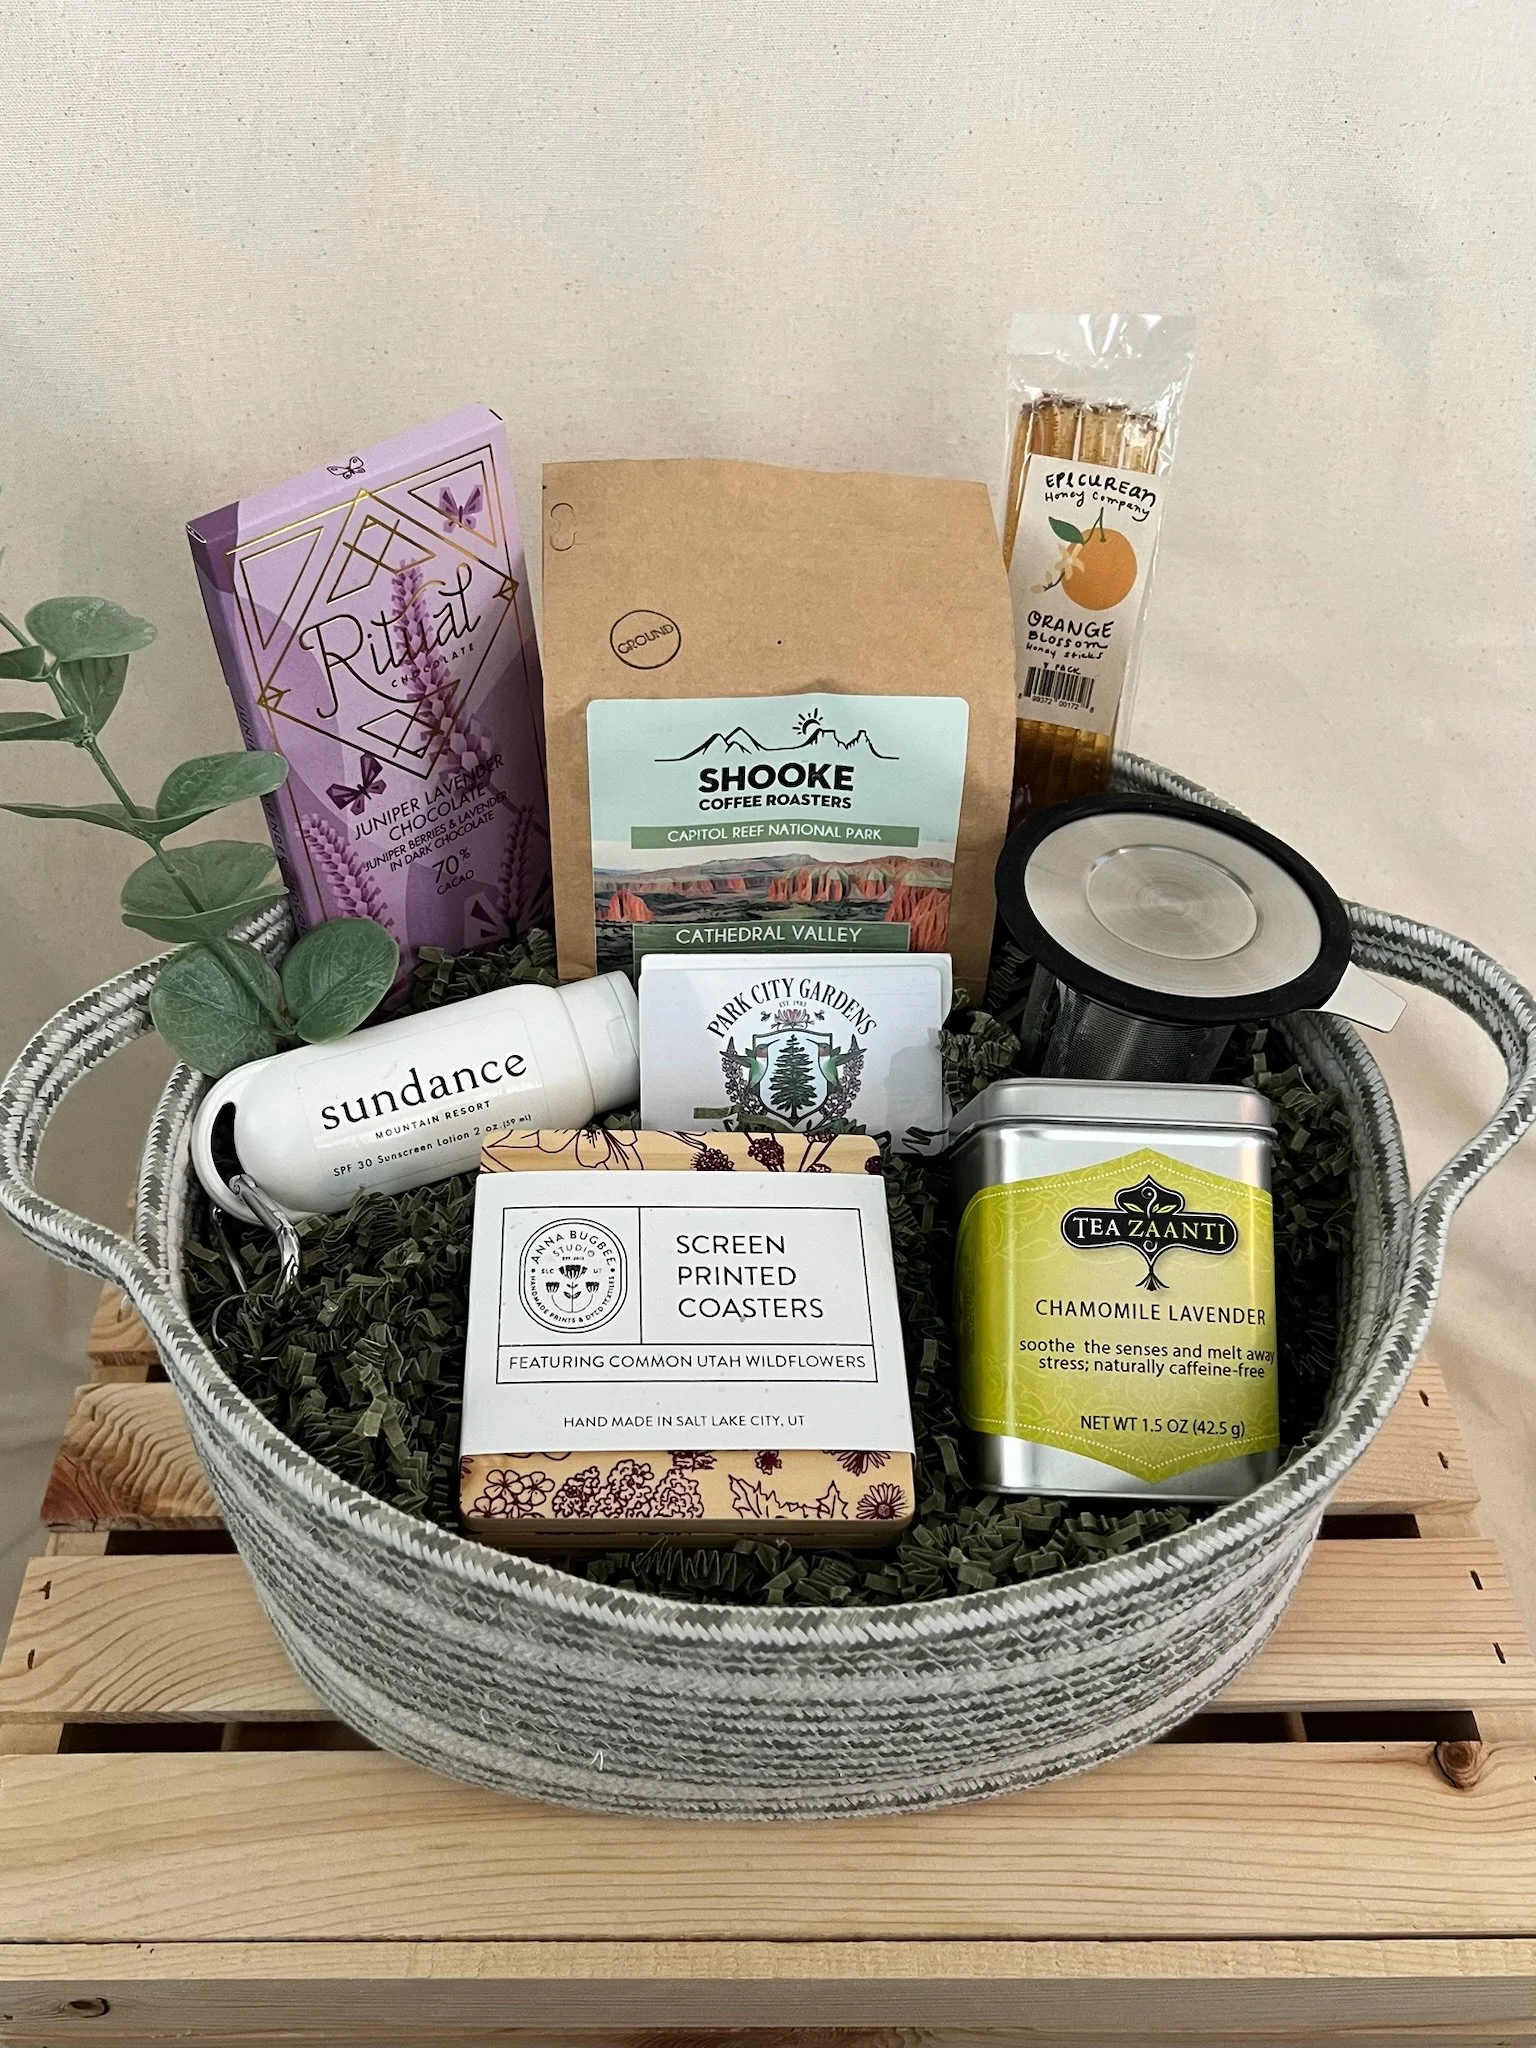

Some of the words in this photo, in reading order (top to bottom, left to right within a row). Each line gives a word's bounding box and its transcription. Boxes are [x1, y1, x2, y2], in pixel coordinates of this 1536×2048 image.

[1045, 490, 1085, 508] Honey
[1027, 610, 1115, 639] ORANGE
[299, 563, 481, 719] Ritual
[616, 623, 674, 655] GROUND
[391, 643, 475, 688] CHOCOLATE
[1055, 664, 1081, 675] PACK
[698, 762, 855, 793] SHOOKE
[355, 797, 421, 841] JUNIPER
[425, 753, 504, 806] LAVENDER
[698, 795, 762, 811] COFFEE
[766, 794, 852, 810] ROASTERS
[389, 782, 486, 841] CHOCOLATE
[364, 844, 407, 873] JUNIPER
[408, 824, 447, 850] BERRIES
[449, 818, 457, 830] &
[458, 790, 508, 825] LAVENDER
[390, 858, 403, 872] IN
[405, 842, 433, 865] DARK
[434, 811, 495, 849] CHOCOLATE
[667, 826, 729, 842] CAPITOL
[732, 824, 765, 839] REEF
[768, 823, 842, 840] NATIONAL
[846, 826, 882, 841] PARK
[437, 869, 474, 895] CACAO
[675, 925, 786, 945] CATHEDRAL
[791, 925, 863, 944] VALLEY
[706, 992, 753, 1038] PARK
[751, 977, 795, 1004] CITY
[799, 978, 877, 1036] GARDENS
[321, 1053, 528, 1131] sundance
[374, 1113, 441, 1140] MOUNTAIN
[444, 1099, 492, 1120] RESORT
[333, 1163, 354, 1177] SPF
[357, 1157, 373, 1170] 30
[377, 1143, 433, 1166] Sunscreen
[436, 1132, 470, 1147] Lotion
[473, 1126, 481, 1136] 2
[676, 1234, 786, 1254] SCREEN
[1072, 1216, 1121, 1239] TEA
[1127, 1219, 1226, 1245] ZAANTI
[531, 1233, 565, 1265] ANNA
[569, 1230, 617, 1266] BUGBEE
[552, 1244, 595, 1257] STUDIO
[677, 1266, 797, 1286] PRINTED
[530, 1275, 550, 1315] HANDMADE
[549, 1312, 576, 1324] PRINTS
[602, 1276, 615, 1306] TEXTILES
[677, 1298, 824, 1319] COASTERS
[1035, 1299, 1161, 1321] CHAMOMILE
[1168, 1305, 1267, 1326] LAVENDER
[509, 1355, 605, 1369] FEATURING
[609, 1355, 692, 1369] COMMON
[698, 1354, 741, 1368] UTAH
[746, 1354, 867, 1369] WILDFLOWERS
[1019, 1338, 1075, 1353] soothe
[1084, 1339, 1110, 1354] the
[1115, 1344, 1168, 1358] senses
[1172, 1343, 1202, 1359] and
[1207, 1345, 1242, 1361] melt
[1246, 1350, 1275, 1365] away
[1038, 1357, 1090, 1373] stress;
[1093, 1359, 1165, 1378] naturally
[1168, 1360, 1265, 1378] caffeine-free
[563, 1416, 608, 1428] HAND
[610, 1415, 655, 1428] MADE
[657, 1415, 673, 1427] IN
[675, 1415, 707, 1427] SALT
[711, 1415, 747, 1427] LAKE
[749, 1415, 784, 1429] CITY,
[787, 1414, 805, 1427] UT
[1080, 1415, 1111, 1430] NET
[1113, 1416, 1138, 1431] WT
[1142, 1417, 1162, 1432] 1.5
[1166, 1418, 1189, 1433] OZ
[1192, 1419, 1228, 1436] (42.5
[1230, 1421, 1246, 1439] g)
